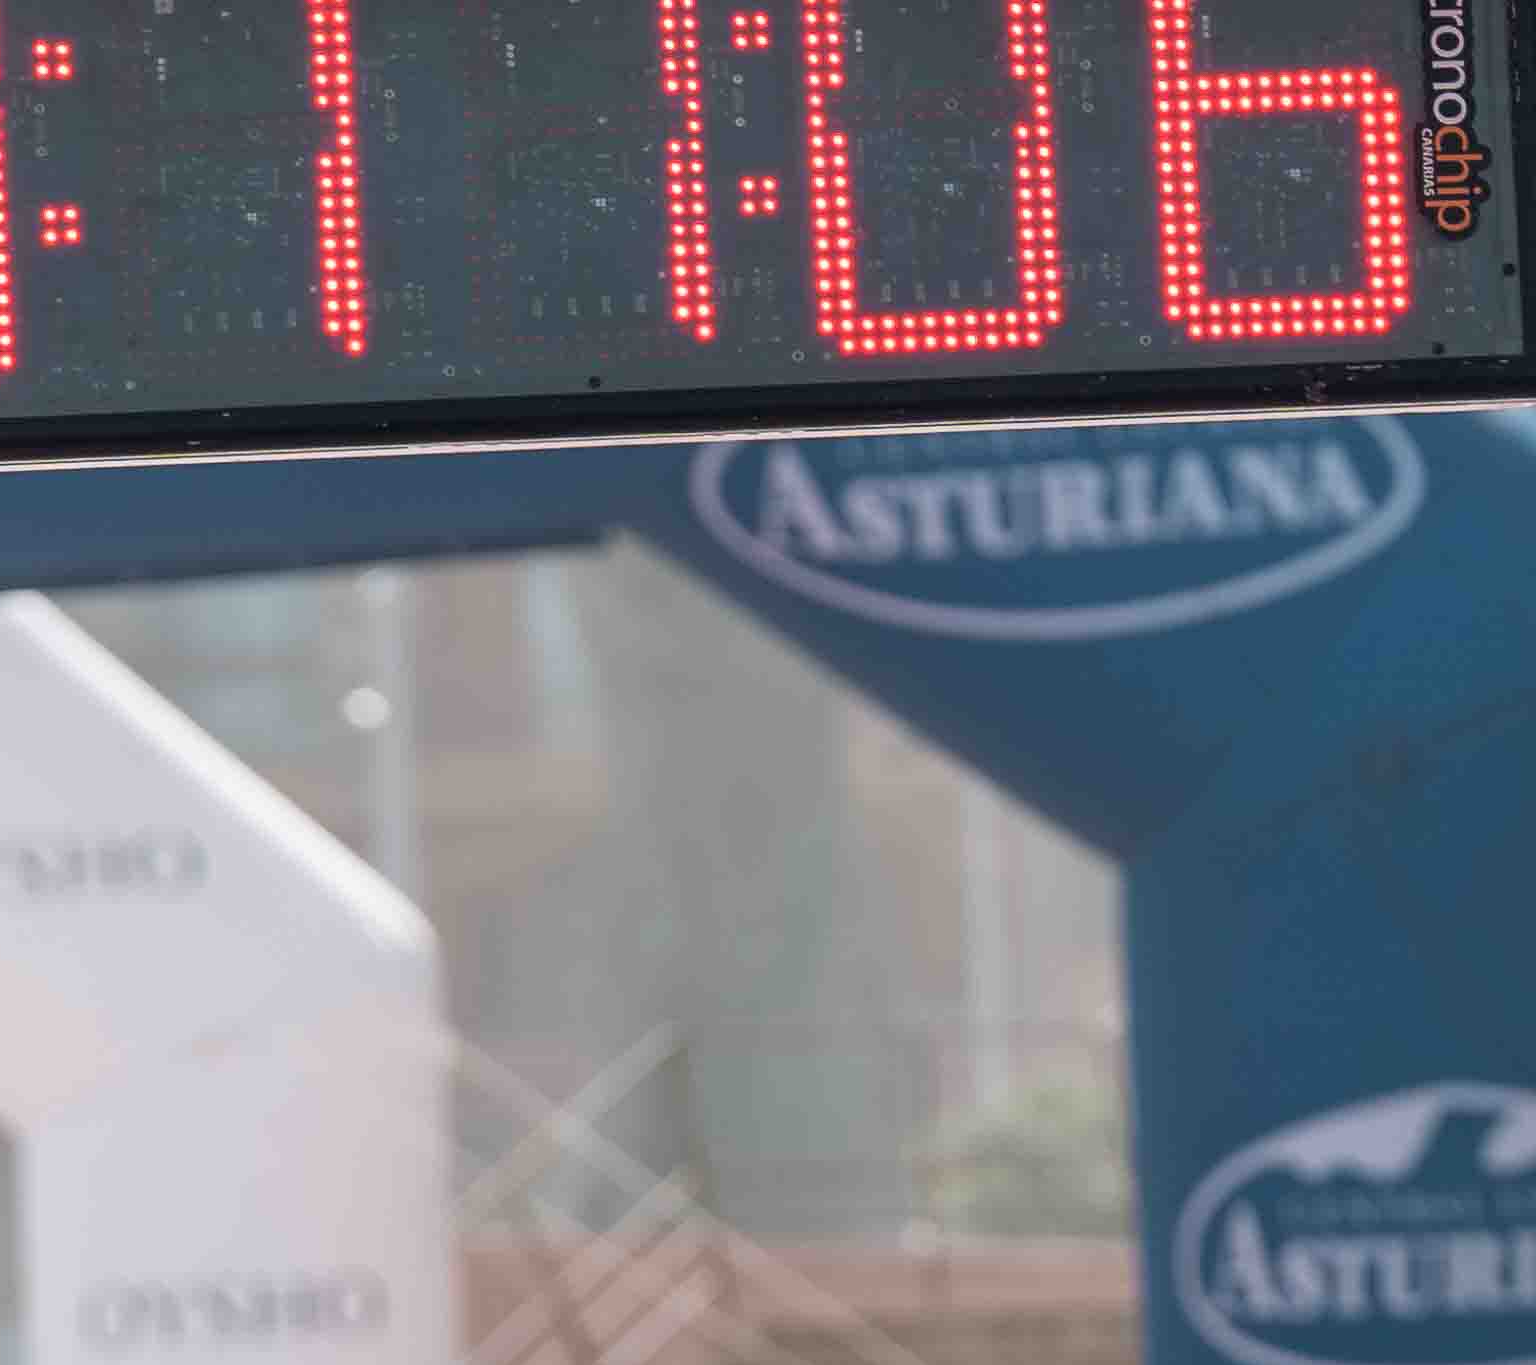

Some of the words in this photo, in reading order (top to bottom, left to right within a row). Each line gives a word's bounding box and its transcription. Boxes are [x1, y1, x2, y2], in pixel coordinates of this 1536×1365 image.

[1421, 128, 1435, 197] CANARIAS
[1424, 0, 1484, 232] ronochip
[756, 440, 1372, 567] ASTURIANA
